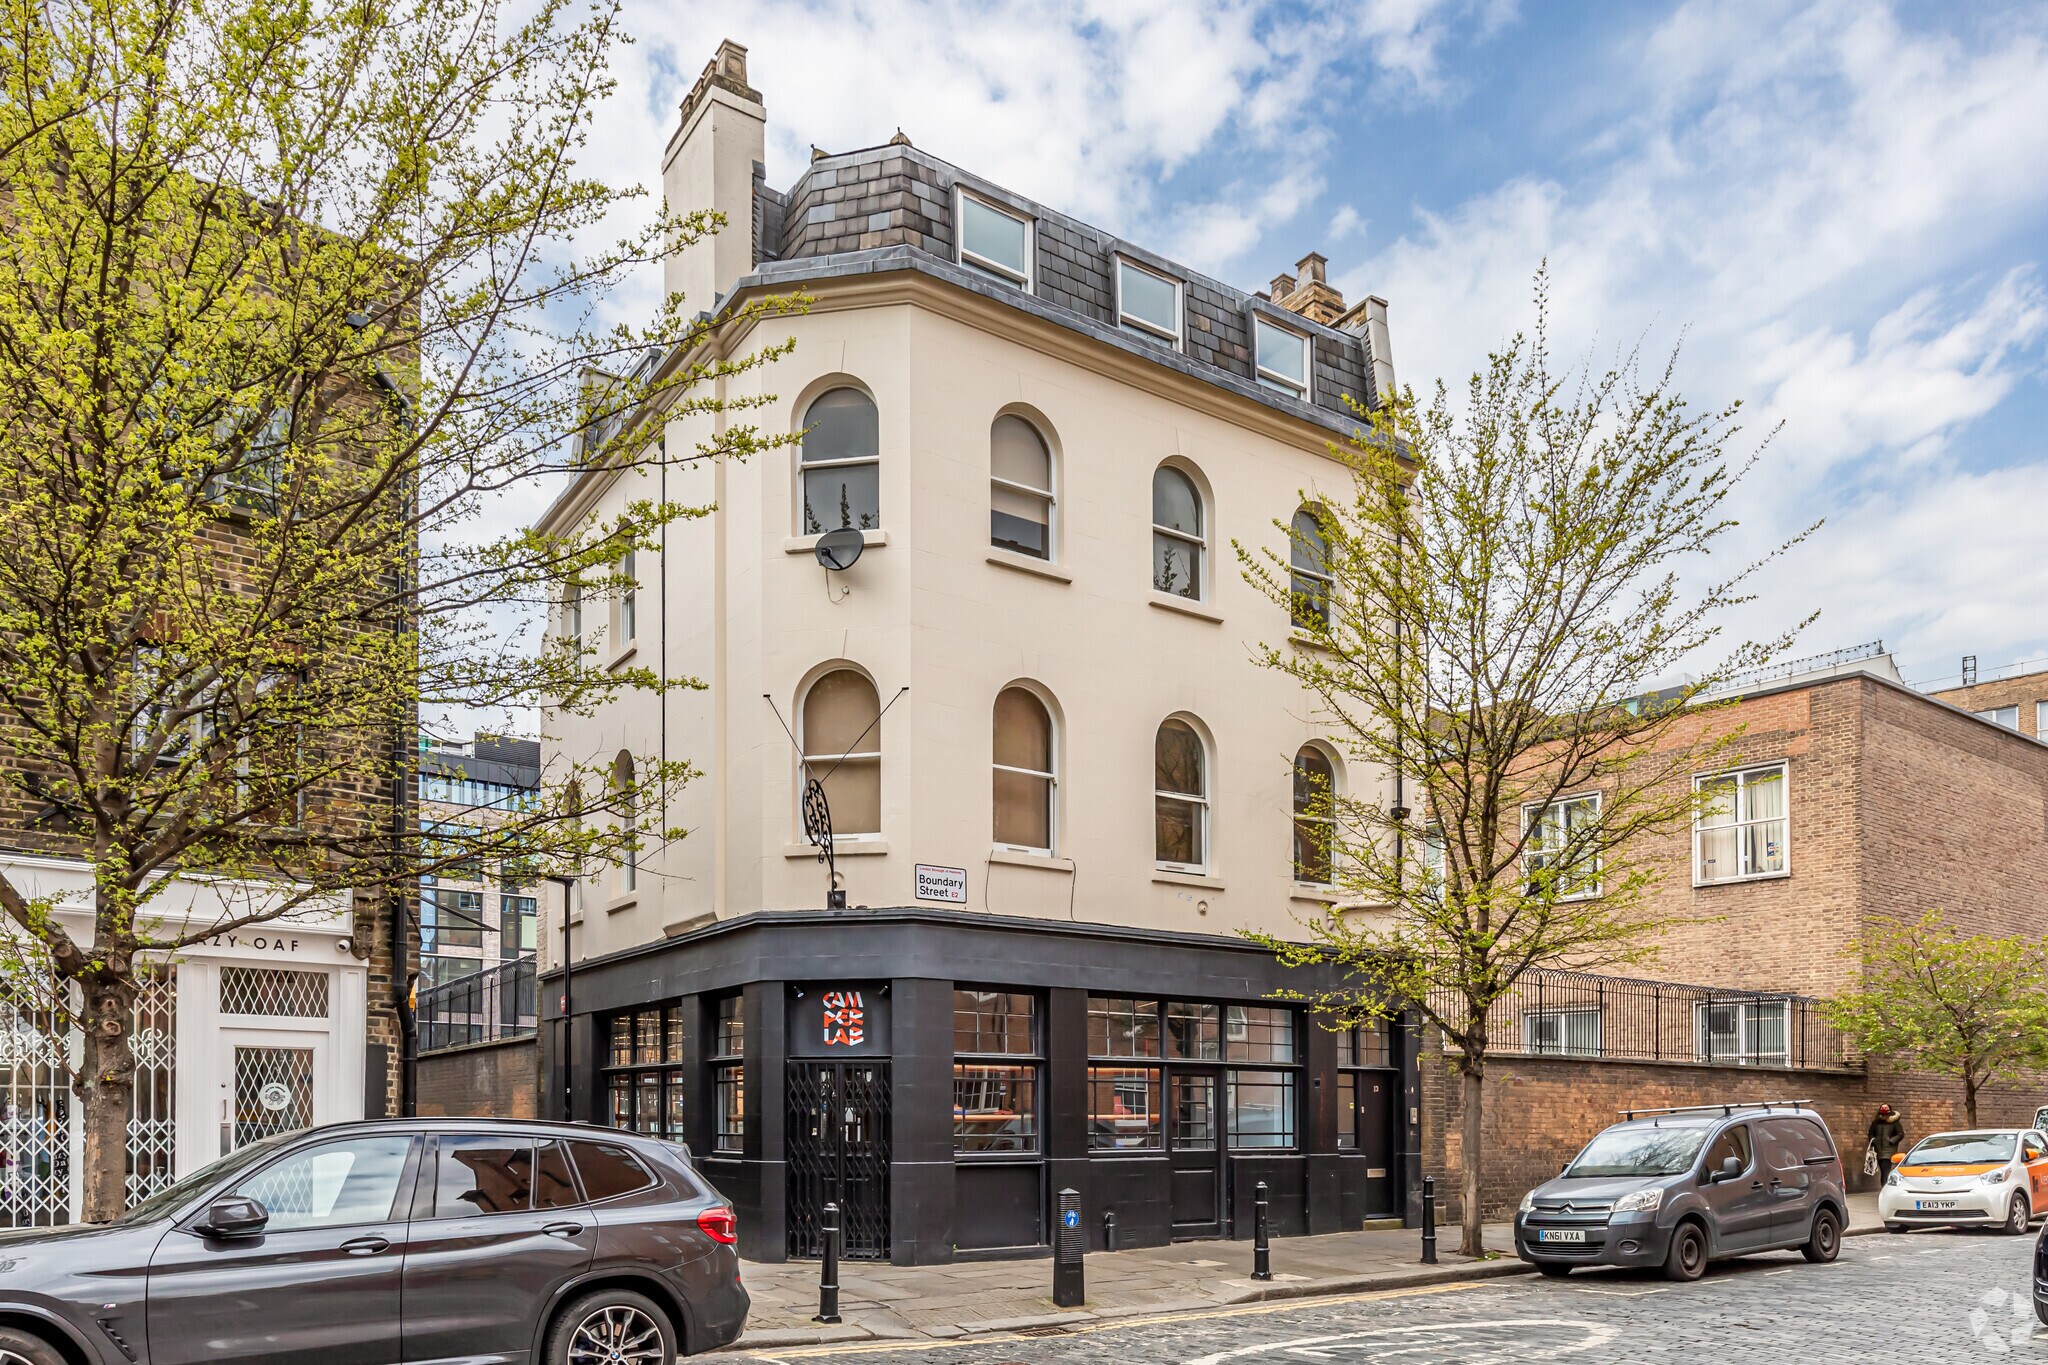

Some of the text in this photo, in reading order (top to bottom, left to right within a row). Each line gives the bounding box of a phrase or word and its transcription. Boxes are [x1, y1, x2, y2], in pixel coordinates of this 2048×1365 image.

[919, 874, 963, 890] Boundary
[920, 885, 949, 898] Street
[254, 937, 299, 952] OAF
[822, 991, 864, 1009] CAM
[823, 1026, 865, 1046] LAB
[1922, 1201, 1956, 1209] EA13 YKP
[1544, 1231, 1580, 1241] KN61 VXA
